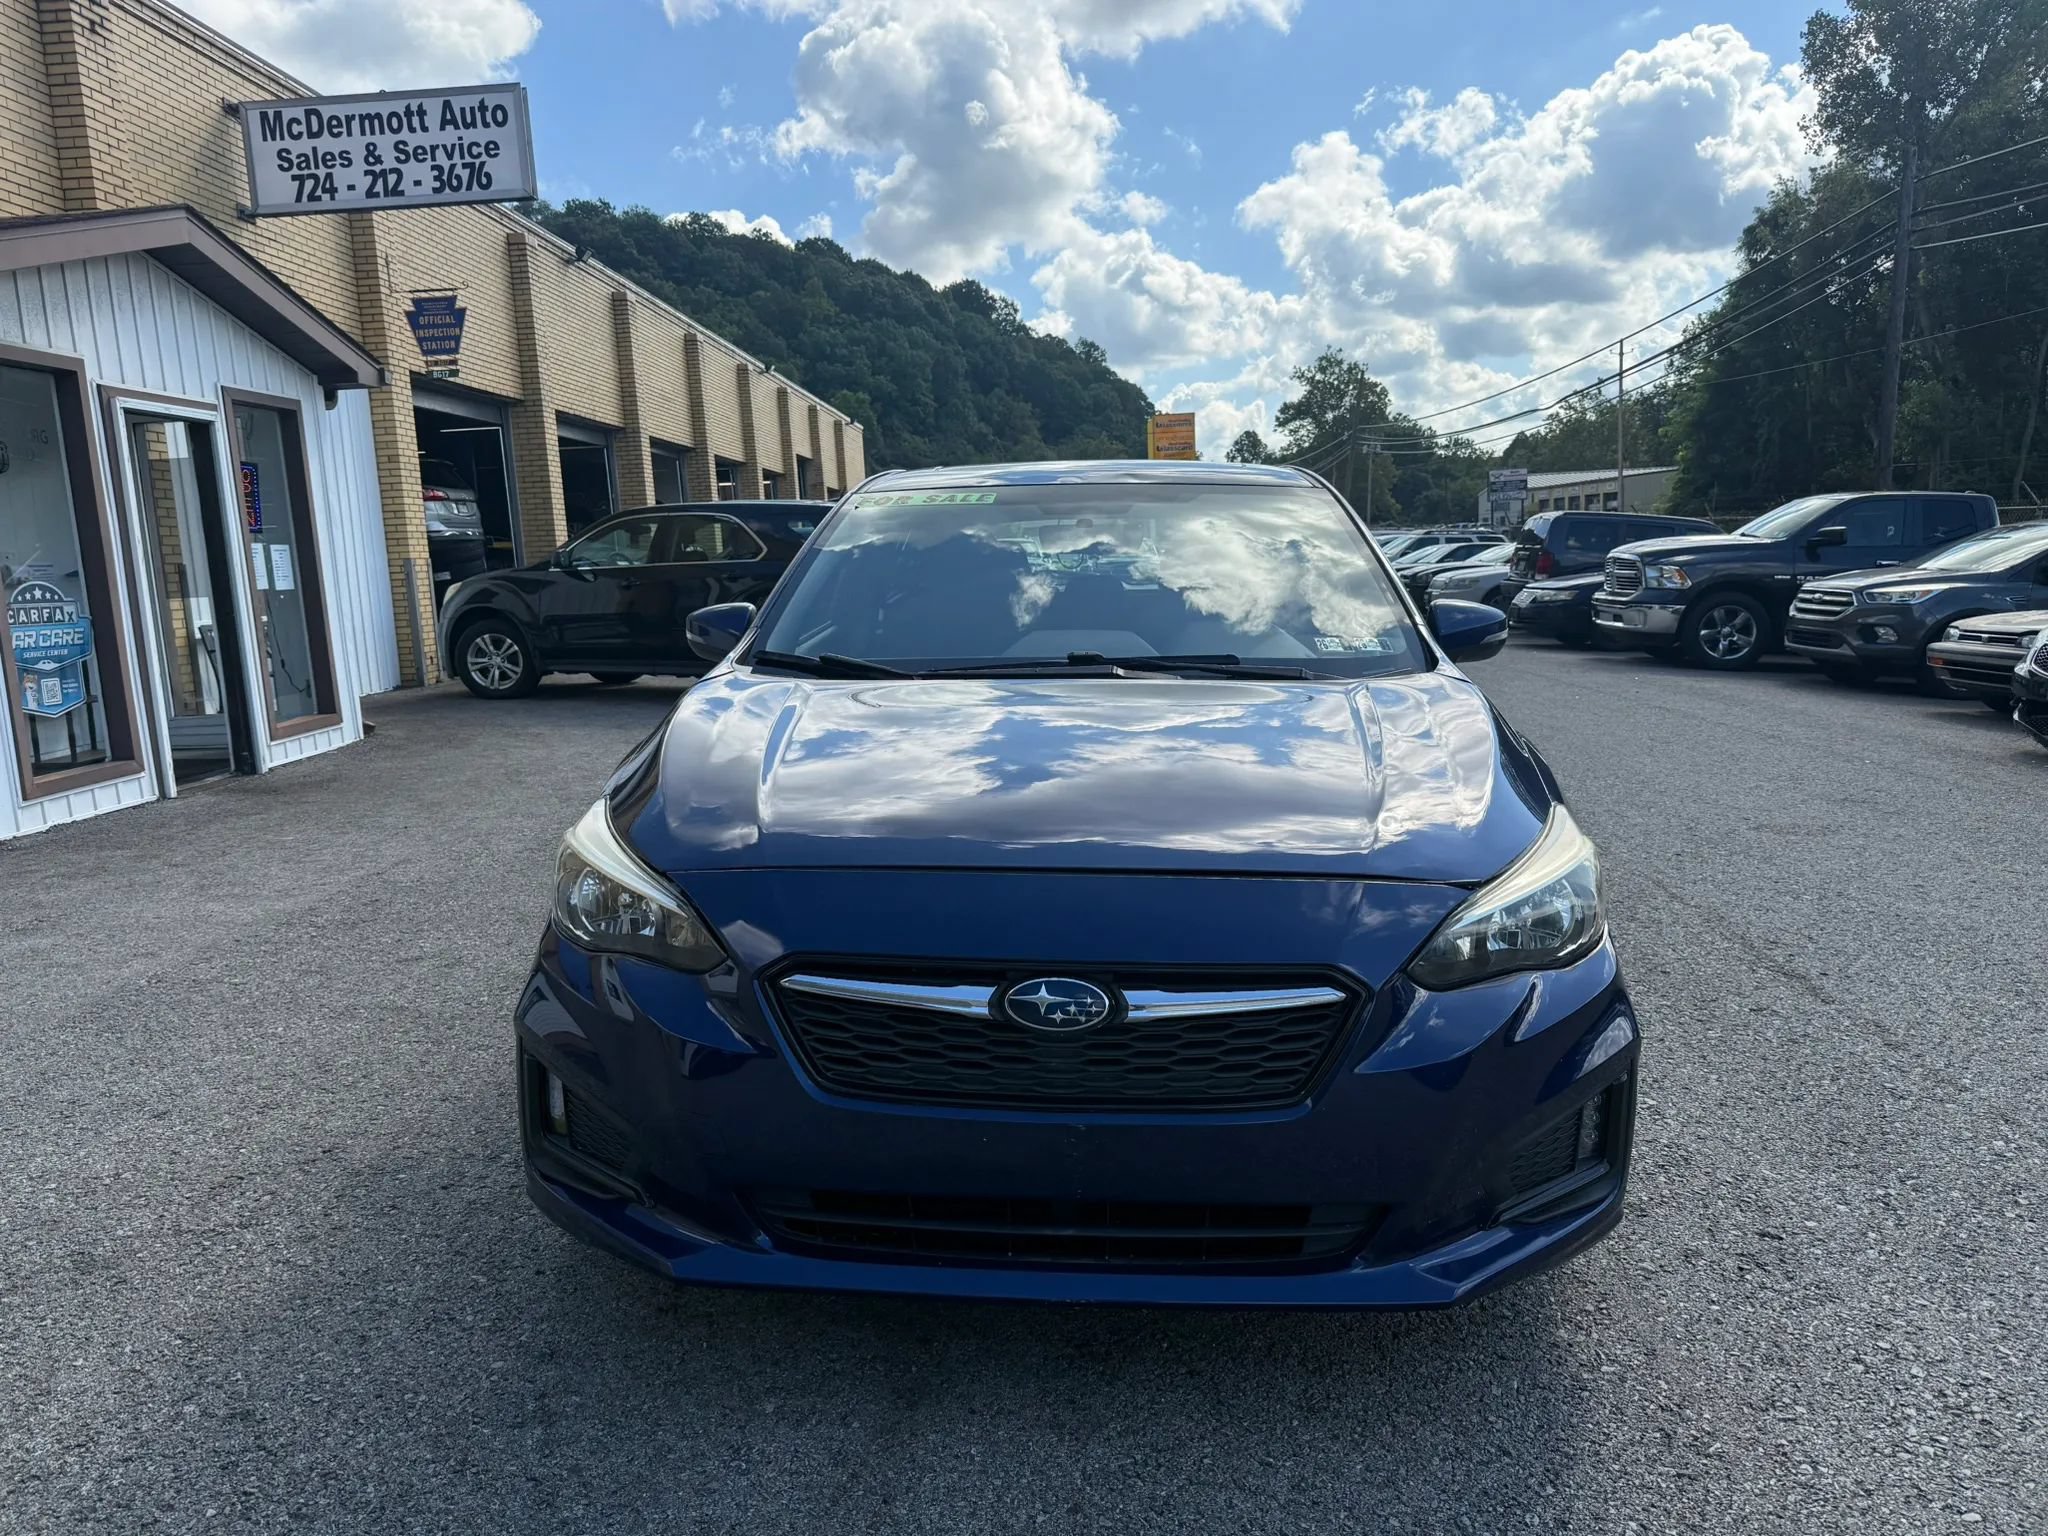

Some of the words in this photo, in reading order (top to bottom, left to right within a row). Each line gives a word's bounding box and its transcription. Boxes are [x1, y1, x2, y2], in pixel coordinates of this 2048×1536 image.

[259, 101, 429, 142] McDermott
[439, 97, 509, 131] Auto
[276, 146, 352, 172] Sales
[364, 142, 384, 167] &
[394, 136, 500, 165] Service
[290, 172, 338, 203] 724
[363, 167, 405, 199] 212
[430, 161, 493, 194] 3676
[419, 315, 456, 325] OFFICIAL
[415, 327, 460, 337] INSPECTION
[422, 340, 456, 350] STATION
[857, 495, 913, 507] FOR
[922, 493, 994, 504] SALE
[8, 607, 74, 624] CARFAX
[12, 630, 37, 649] AR
[39, 627, 85, 648] CARE
[23, 650, 46, 659] SERVICE
[47, 649, 68, 657] CENTER
